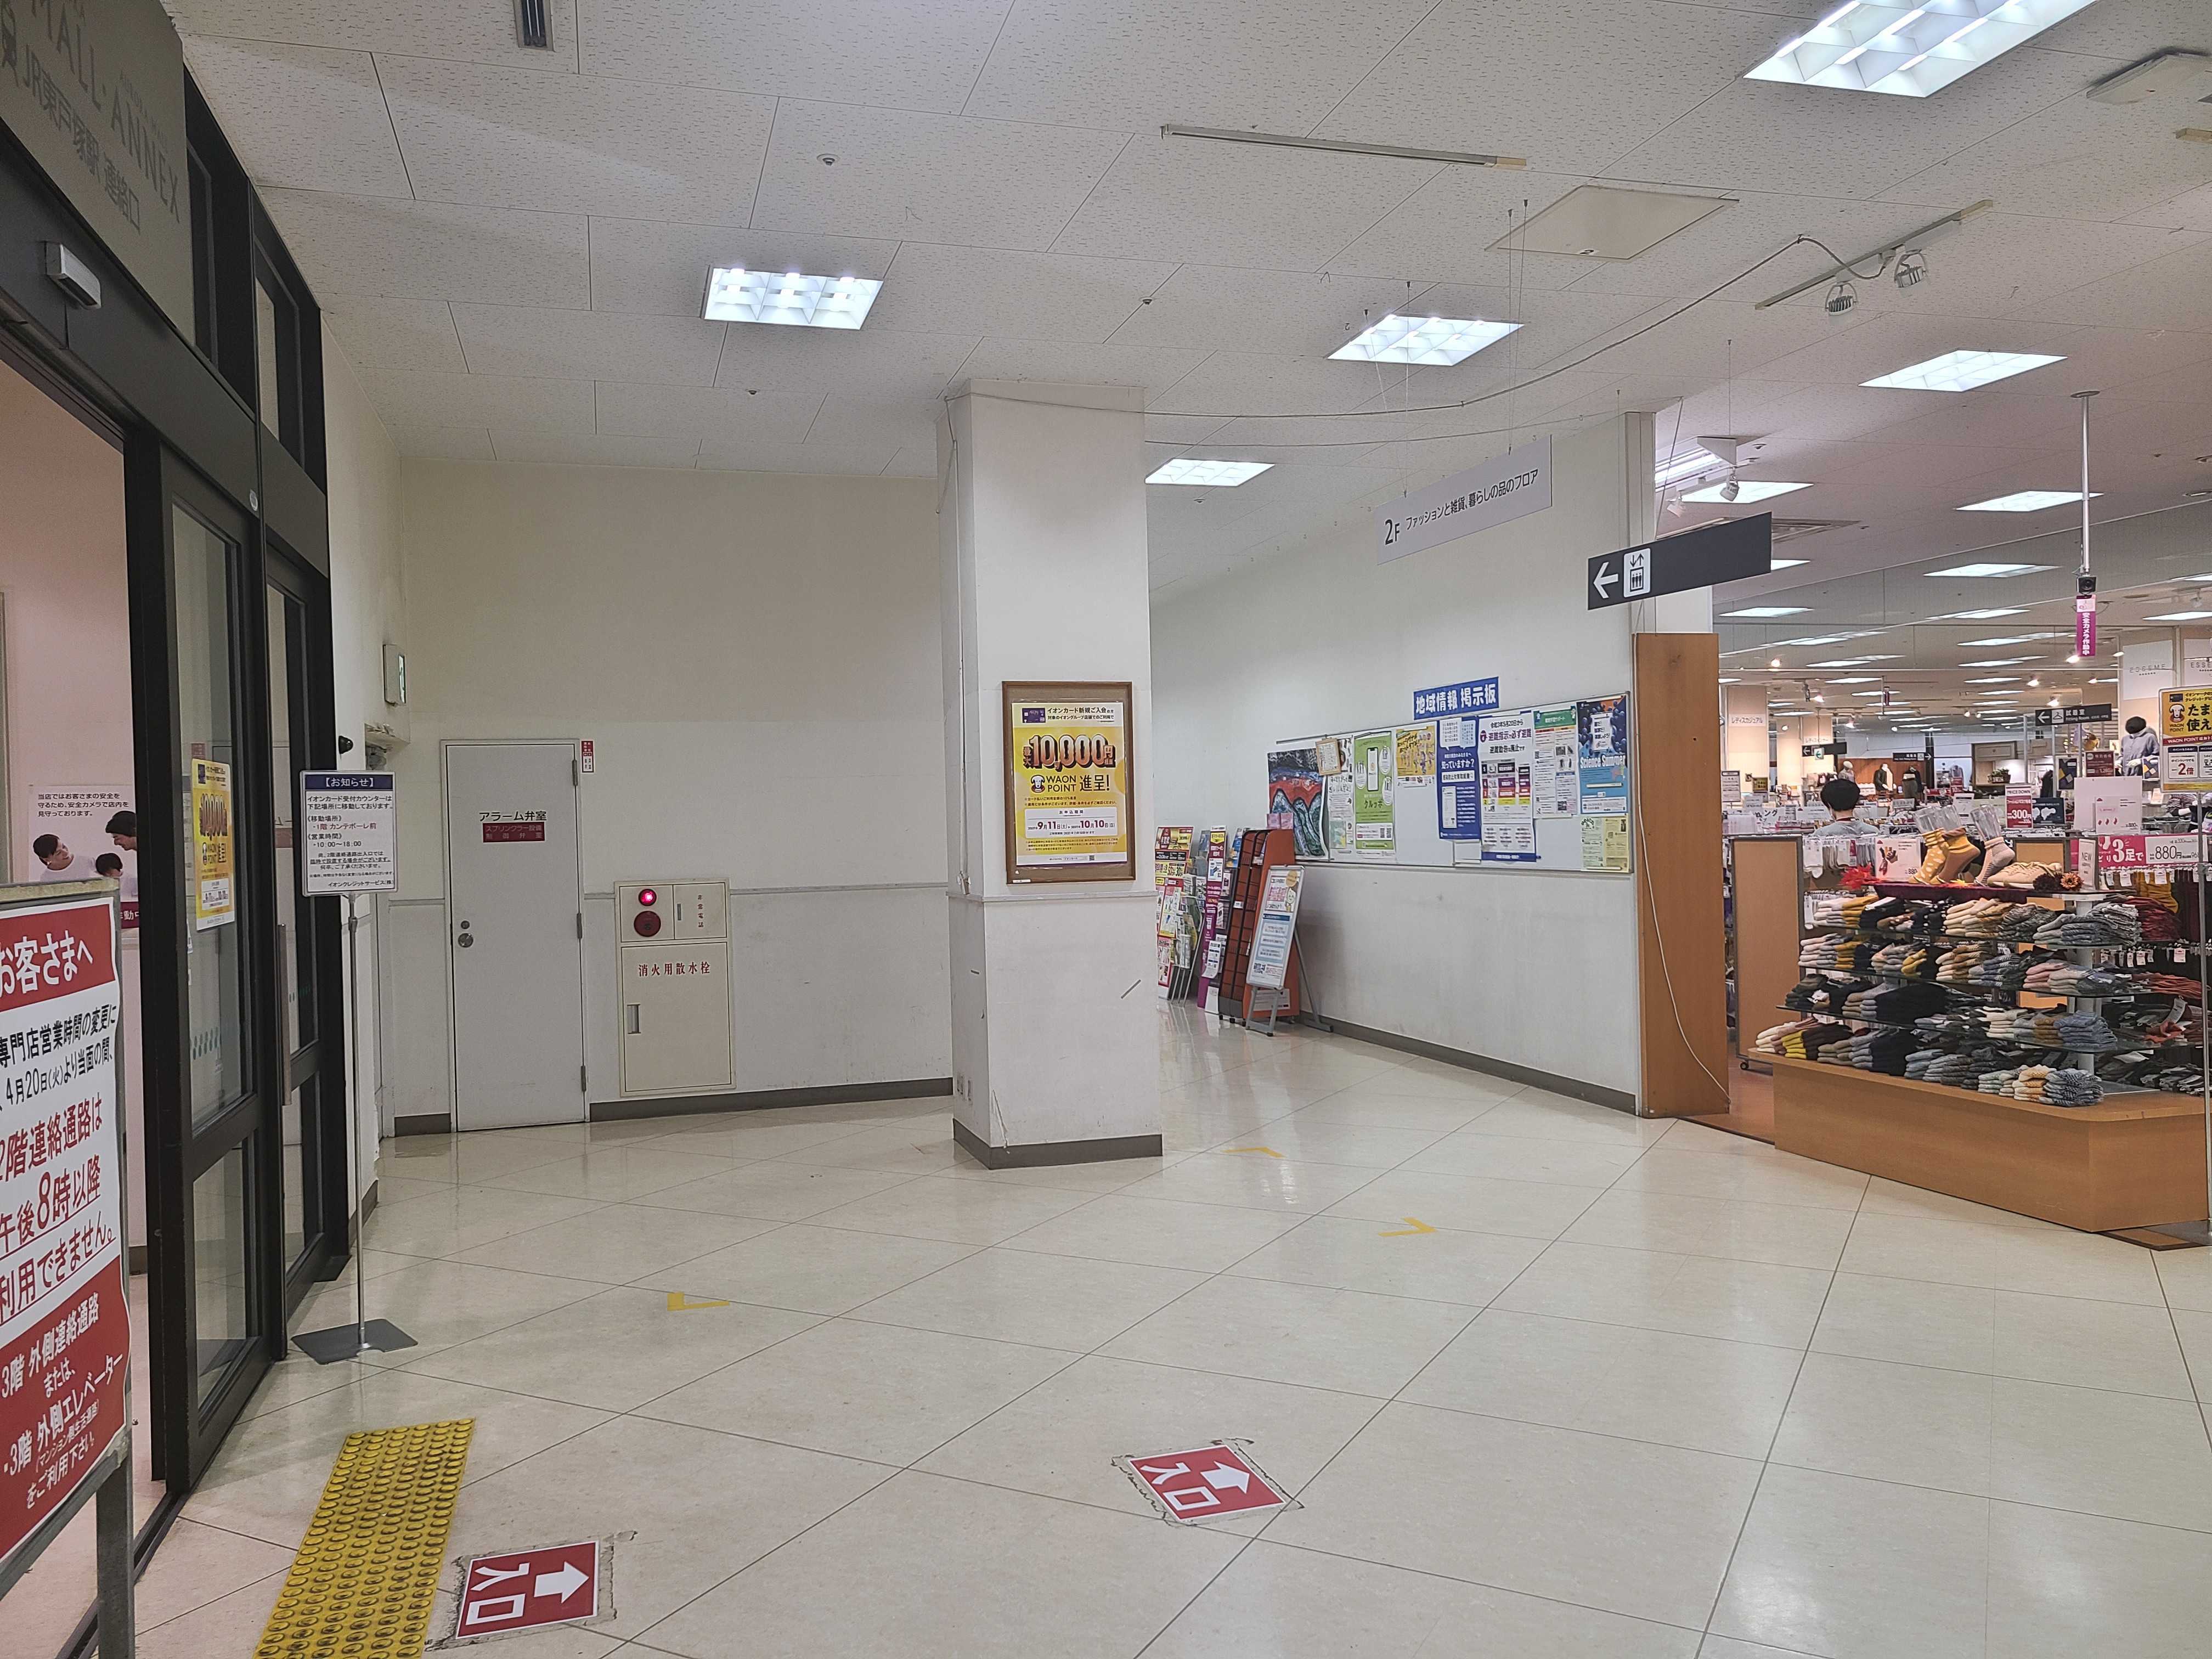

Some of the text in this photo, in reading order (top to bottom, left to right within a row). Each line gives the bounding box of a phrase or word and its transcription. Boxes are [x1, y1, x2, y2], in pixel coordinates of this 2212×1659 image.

[1385, 469, 1538, 545] 2F ファッションと雑貨、暮らしの品のフロア
[1416, 684, 1496, 714] 地域情報 掲示板
[479, 811, 547, 822] アラーム弁室
[0, 930, 94, 997] お客さまへ
[639, 961, 710, 977] 消火用散水栓
[0, 1154, 100, 1251] 午後8時以降
[29, 1291, 99, 1378] 外側連絡通路
[37, 1353, 123, 1452] 外側エレベーター
[44, 1357, 76, 1398] または、
[1140, 1462, 1221, 1510] 入口
[466, 1562, 530, 1626] 入口
